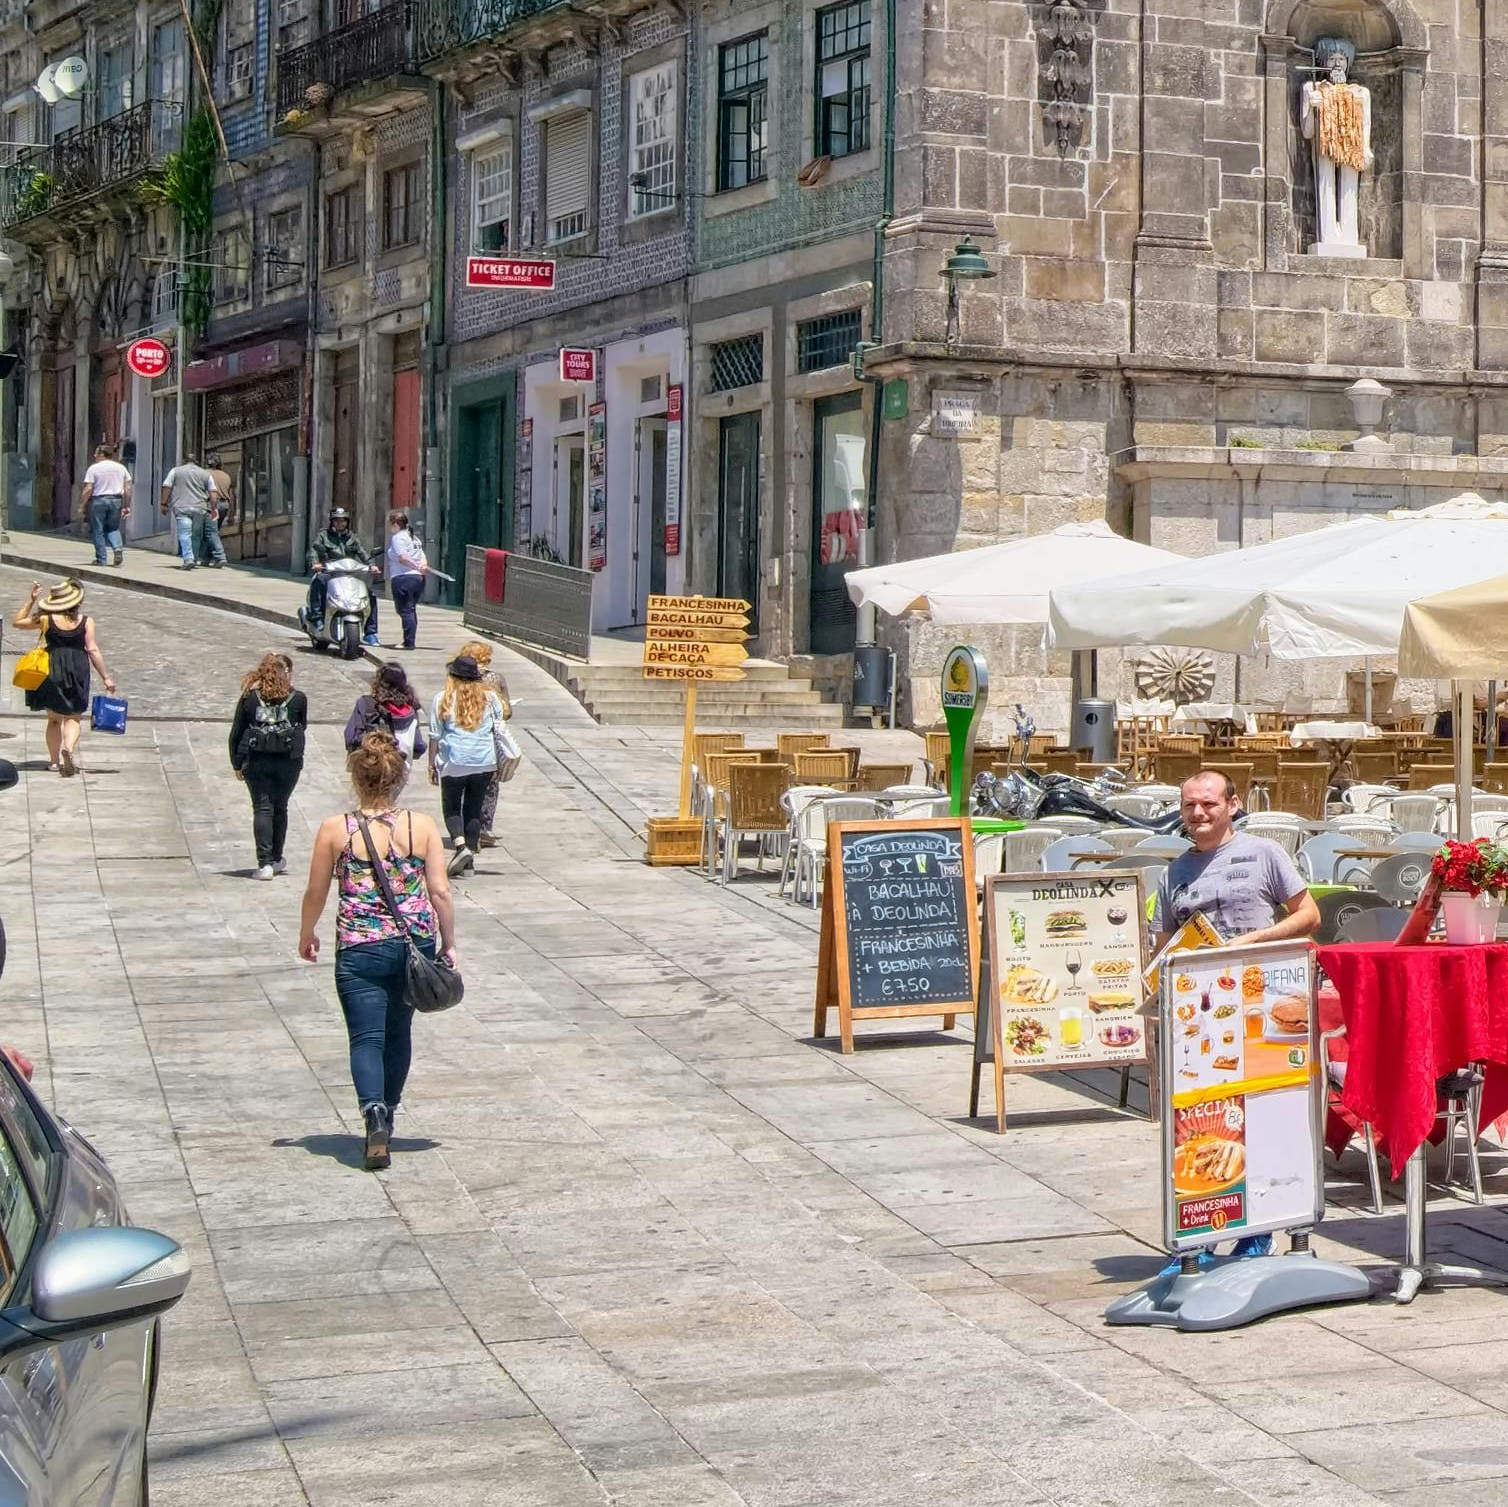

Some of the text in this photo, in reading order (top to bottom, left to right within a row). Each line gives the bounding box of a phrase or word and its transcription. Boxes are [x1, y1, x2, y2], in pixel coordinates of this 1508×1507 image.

[472, 263, 551, 277] TICKET OFFICE
[566, 361, 590, 369] TOURS
[651, 598, 745, 611] FRANCESINHA
[651, 613, 723, 625] BACALHAU
[650, 629, 694, 638] POLVO
[649, 643, 710, 653] ALHEIRA
[648, 653, 705, 665] DE CAÇA
[647, 668, 713, 678] PETISCOS
[857, 843, 887, 854] CASA
[868, 882, 951, 900] BACALHAU
[1032, 887, 1097, 901] DEOLINDA
[860, 933, 959, 955] FRANCESINHA
[878, 956, 931, 974] BEBIDA
[1262, 967, 1305, 988] BIFANA
[1179, 1098, 1236, 1121] SPECIAL
[1183, 1195, 1239, 1215] FRANCESINHA
[1190, 1214, 1209, 1226] Drink
